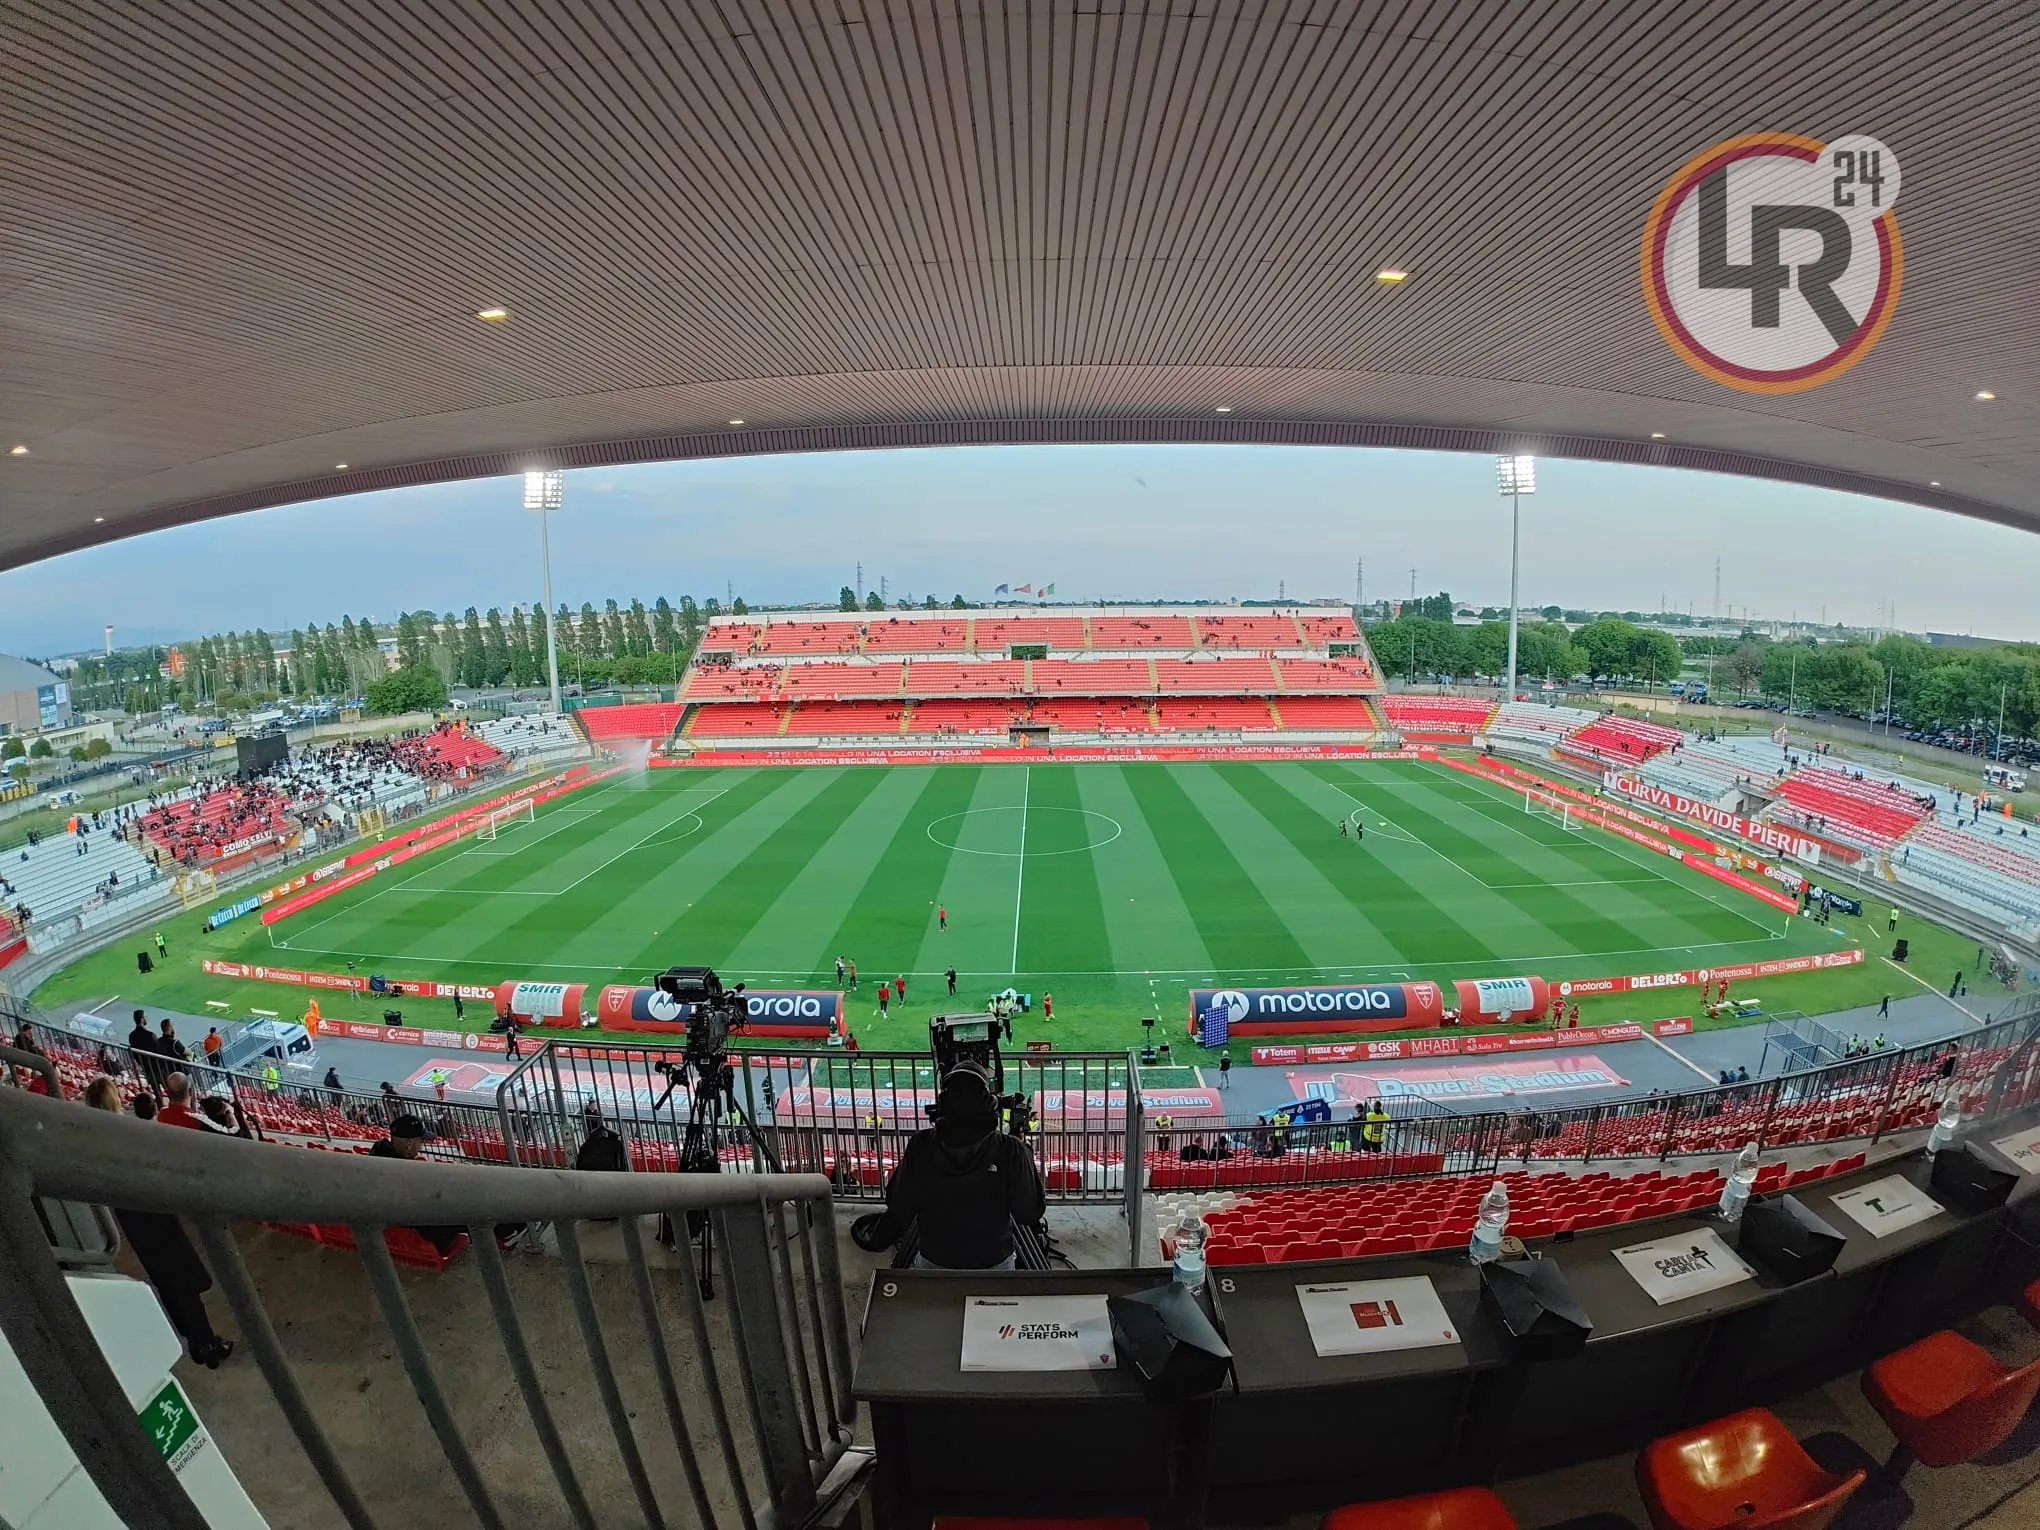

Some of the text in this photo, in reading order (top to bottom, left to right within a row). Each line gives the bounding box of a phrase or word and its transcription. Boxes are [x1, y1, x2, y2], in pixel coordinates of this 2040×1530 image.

[1592, 797, 1627, 817] LOCATION
[1616, 777, 1798, 855] CURVA DAVIDE PIERI
[223, 839, 249, 853] COMO
[264, 968, 302, 982] Pontenossa
[1710, 967, 1753, 980] Pontenossa
[518, 983, 564, 994] SMIR
[1480, 980, 1526, 991] SMIR
[1573, 981, 1613, 992] motorola
[1259, 988, 1391, 1014] motorola
[1271, 1047, 1297, 1057] Totem
[1378, 1041, 1401, 1052] GSK
[1411, 1038, 1458, 1052] MHART
[1482, 1069, 1609, 1094] Stadium
[882, 1282, 898, 1297] 9
[1221, 1278, 1236, 1293] 8
[1020, 1323, 1060, 1332] STATS
[1018, 1330, 1079, 1340] PERFORM
[171, 1442, 192, 1466] SCALA
[174, 1437, 208, 1475] MERGENZA
